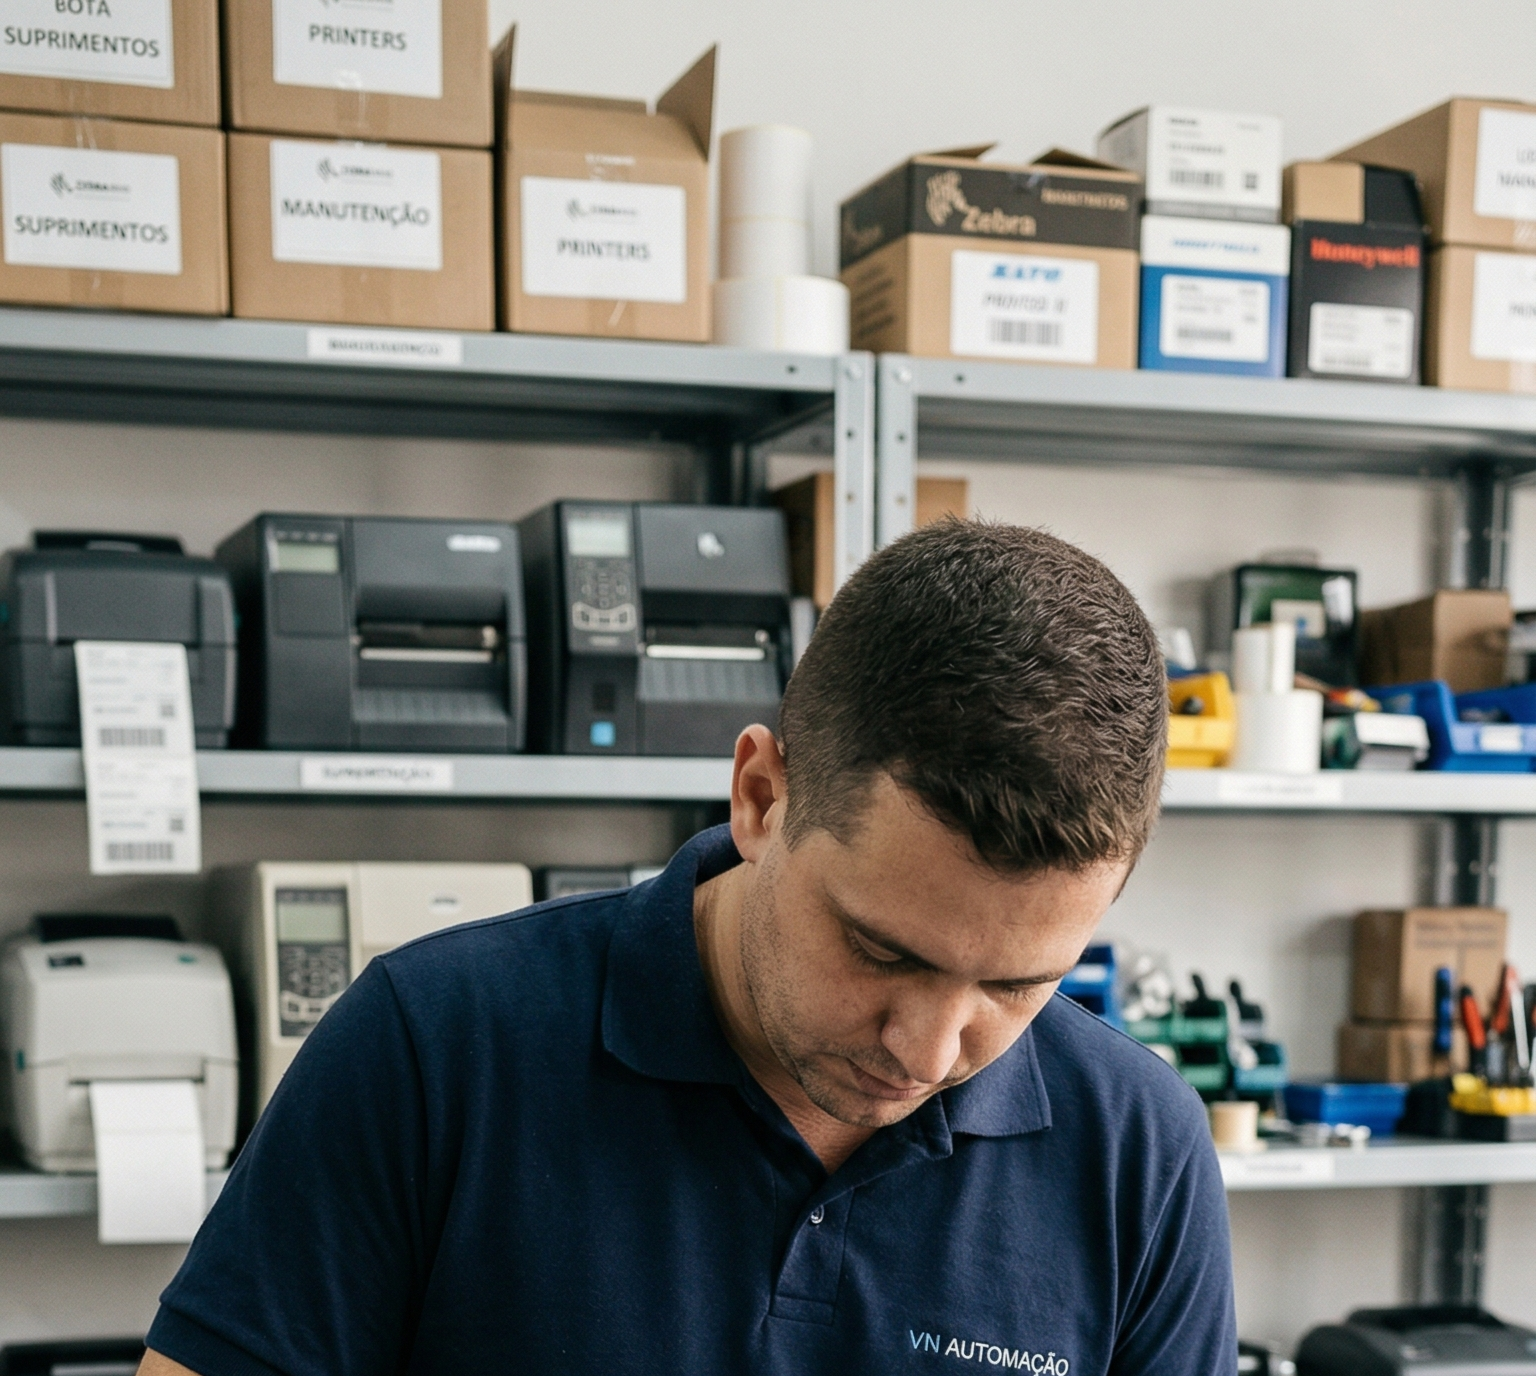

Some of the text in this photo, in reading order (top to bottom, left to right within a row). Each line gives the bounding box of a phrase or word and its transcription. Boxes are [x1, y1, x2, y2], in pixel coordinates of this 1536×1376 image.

[4, 25, 160, 58] SUPRIMENTOS
[308, 23, 407, 51] PRINTERS
[14, 213, 169, 244] SUPRIMENTOS
[280, 198, 431, 229] MANUTENÇÃO
[960, 206, 1037, 237] Zebra
[557, 238, 651, 263] PRINTERS
[1310, 237, 1419, 270] Honeywell
[909, 1329, 941, 1353] VN
